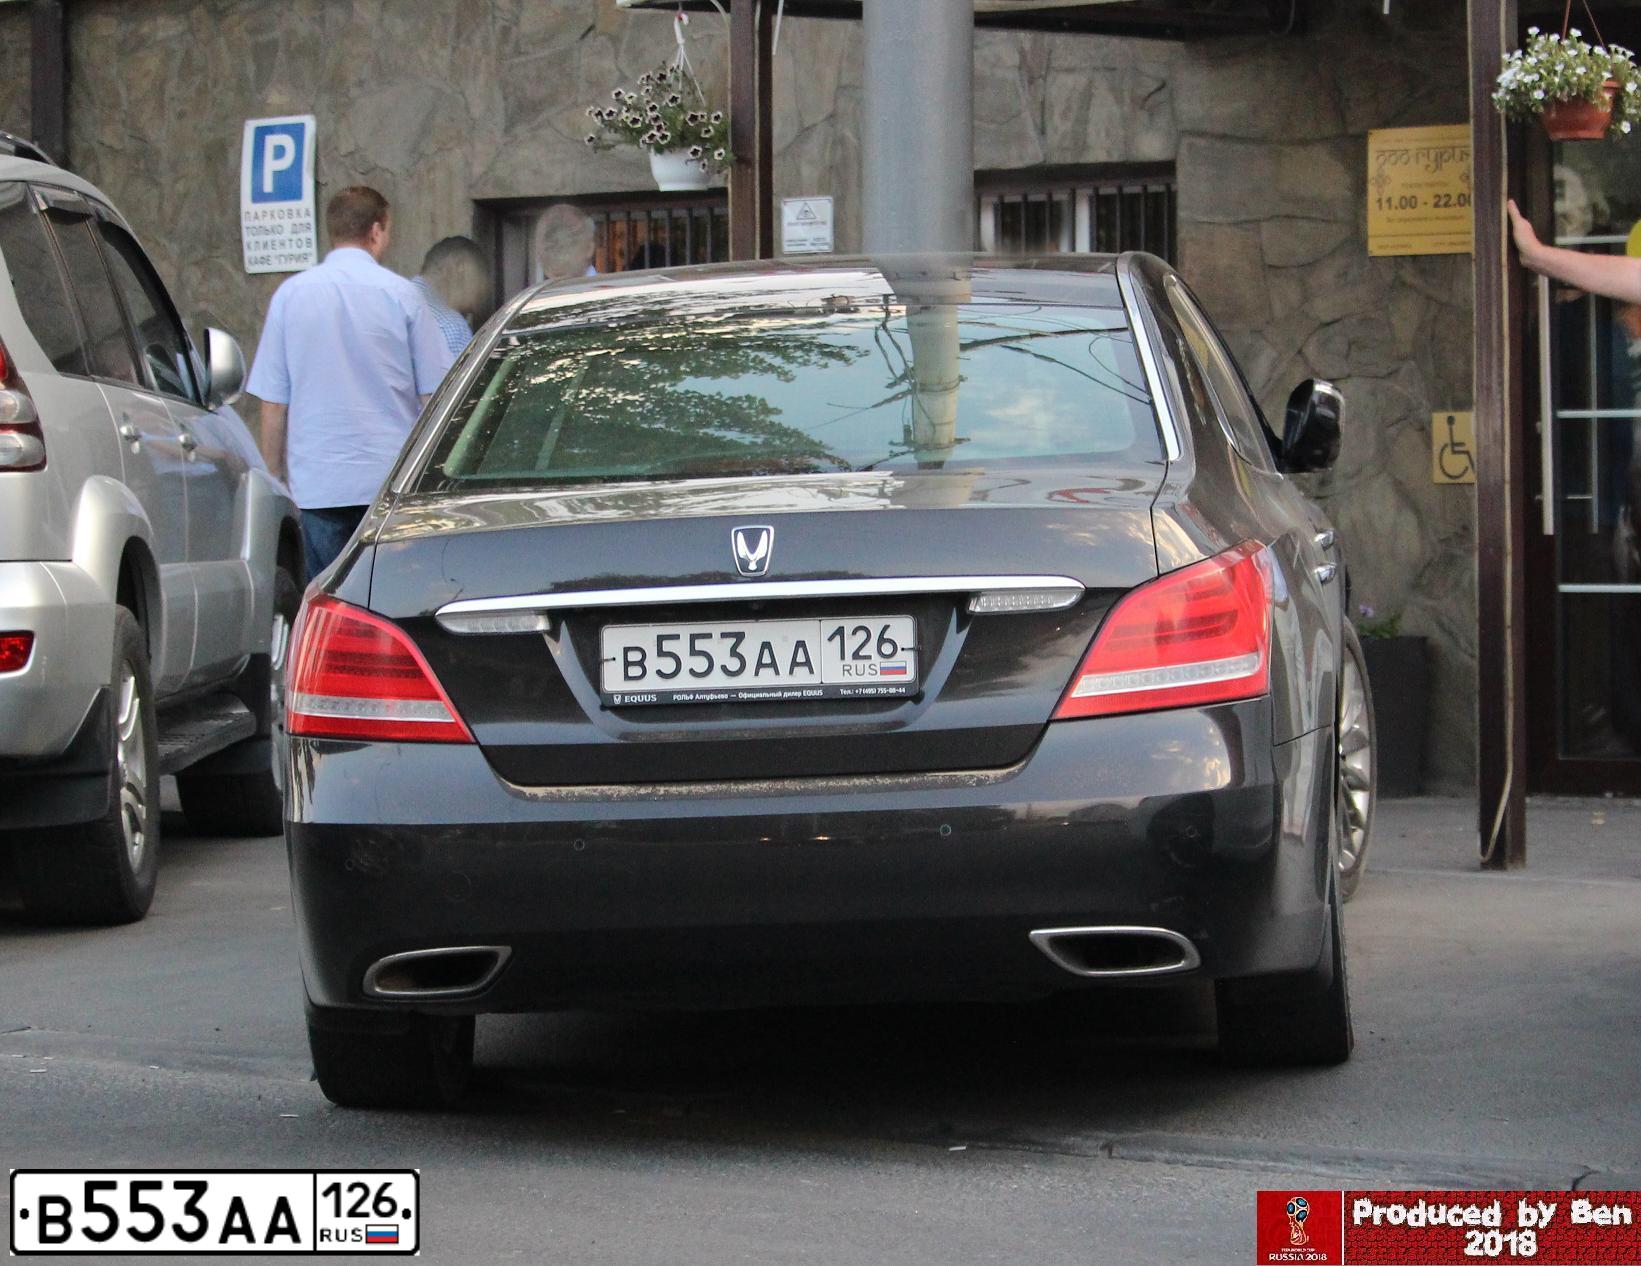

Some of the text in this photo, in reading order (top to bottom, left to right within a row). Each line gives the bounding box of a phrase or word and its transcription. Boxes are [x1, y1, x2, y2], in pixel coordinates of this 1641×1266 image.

[263, 134, 296, 193] P
[1376, 195, 1418, 211] 11.00
[244, 208, 311, 221] ПАРКОВКА
[245, 222, 312, 237] ТОЛЬКО ДЛЯ
[246, 237, 313, 251] КЛИЕНТОВ
[248, 255, 272, 266] КАФЕ
[827, 624, 899, 662] 126
[842, 664, 878, 677] RUS
[624, 694, 657, 703] EQUUS
[803, 689, 823, 697] EQUUS
